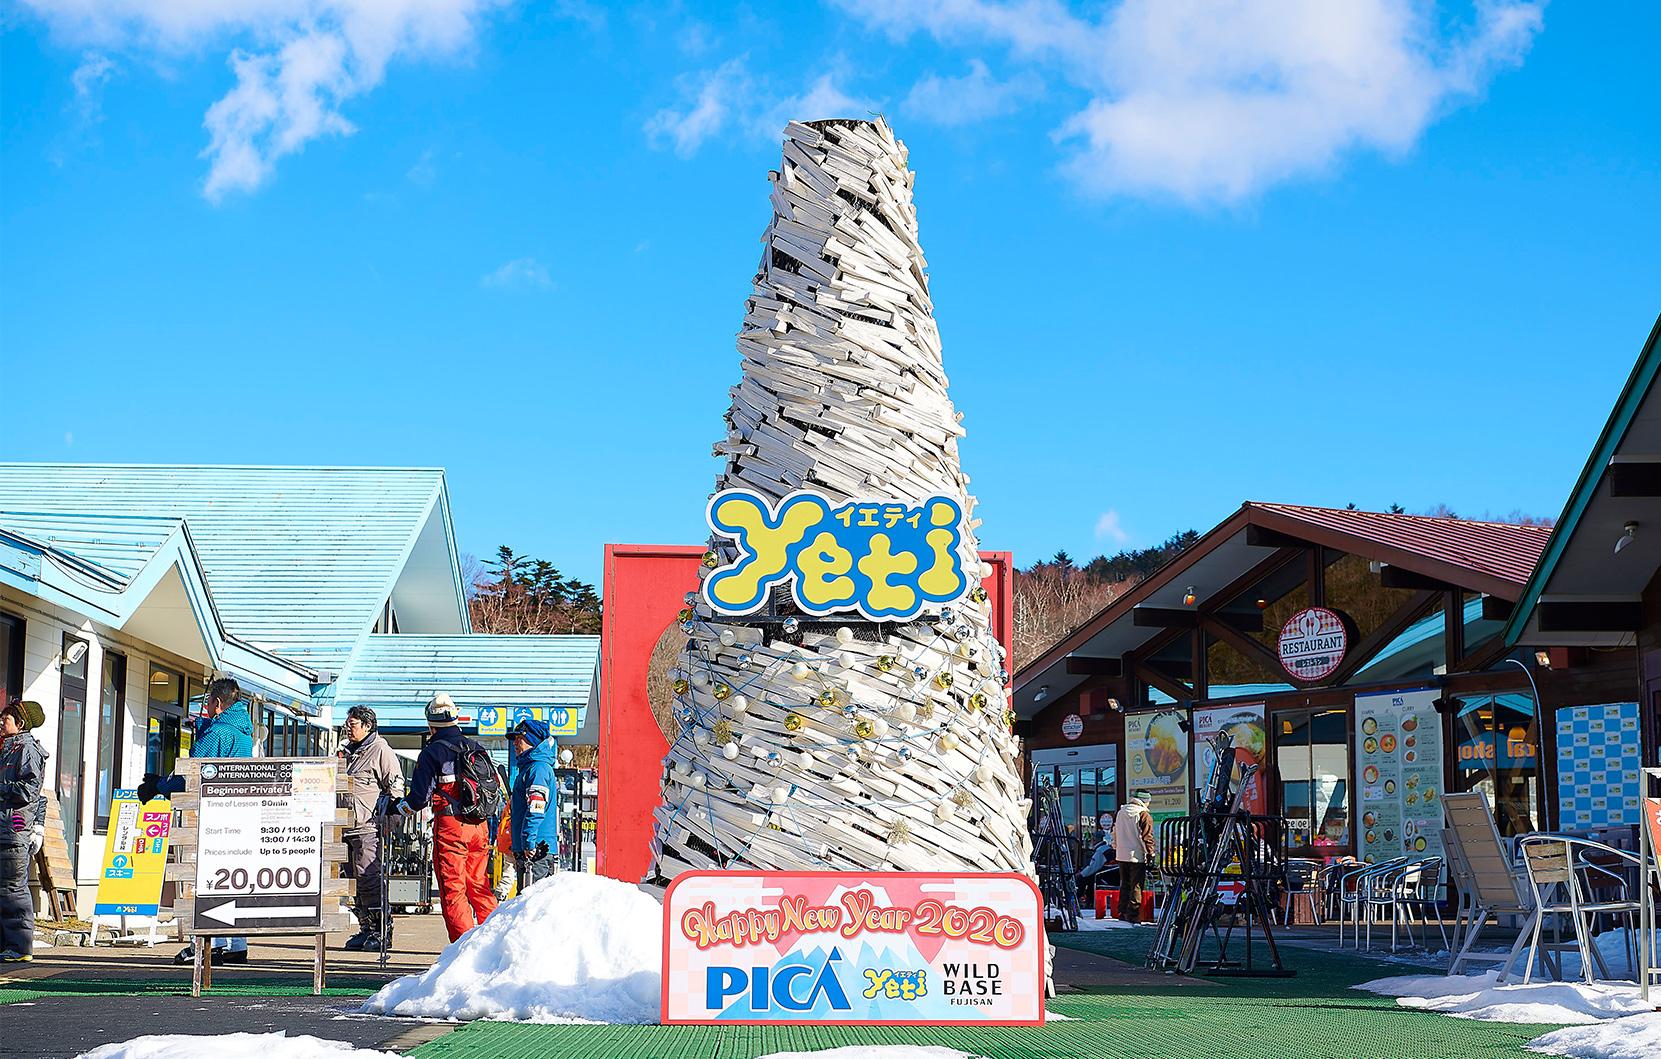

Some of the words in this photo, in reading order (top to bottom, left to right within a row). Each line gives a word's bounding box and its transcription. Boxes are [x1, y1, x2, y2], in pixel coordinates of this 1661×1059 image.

[835, 505, 921, 529] イエティ
[1282, 636, 1343, 655] RESTAURANT
[207, 786, 248, 796] Beginner
[250, 785, 283, 794] Private
[205, 827, 223, 835] Start
[108, 869, 131, 877] スキー
[682, 900, 781, 949] Happy
[782, 894, 842, 934] New
[841, 889, 912, 937] Year
[915, 898, 1025, 949] 2020
[943, 963, 1000, 979] WILD
[943, 980, 1002, 996] BASE
[950, 998, 993, 1006] FUJISAN
